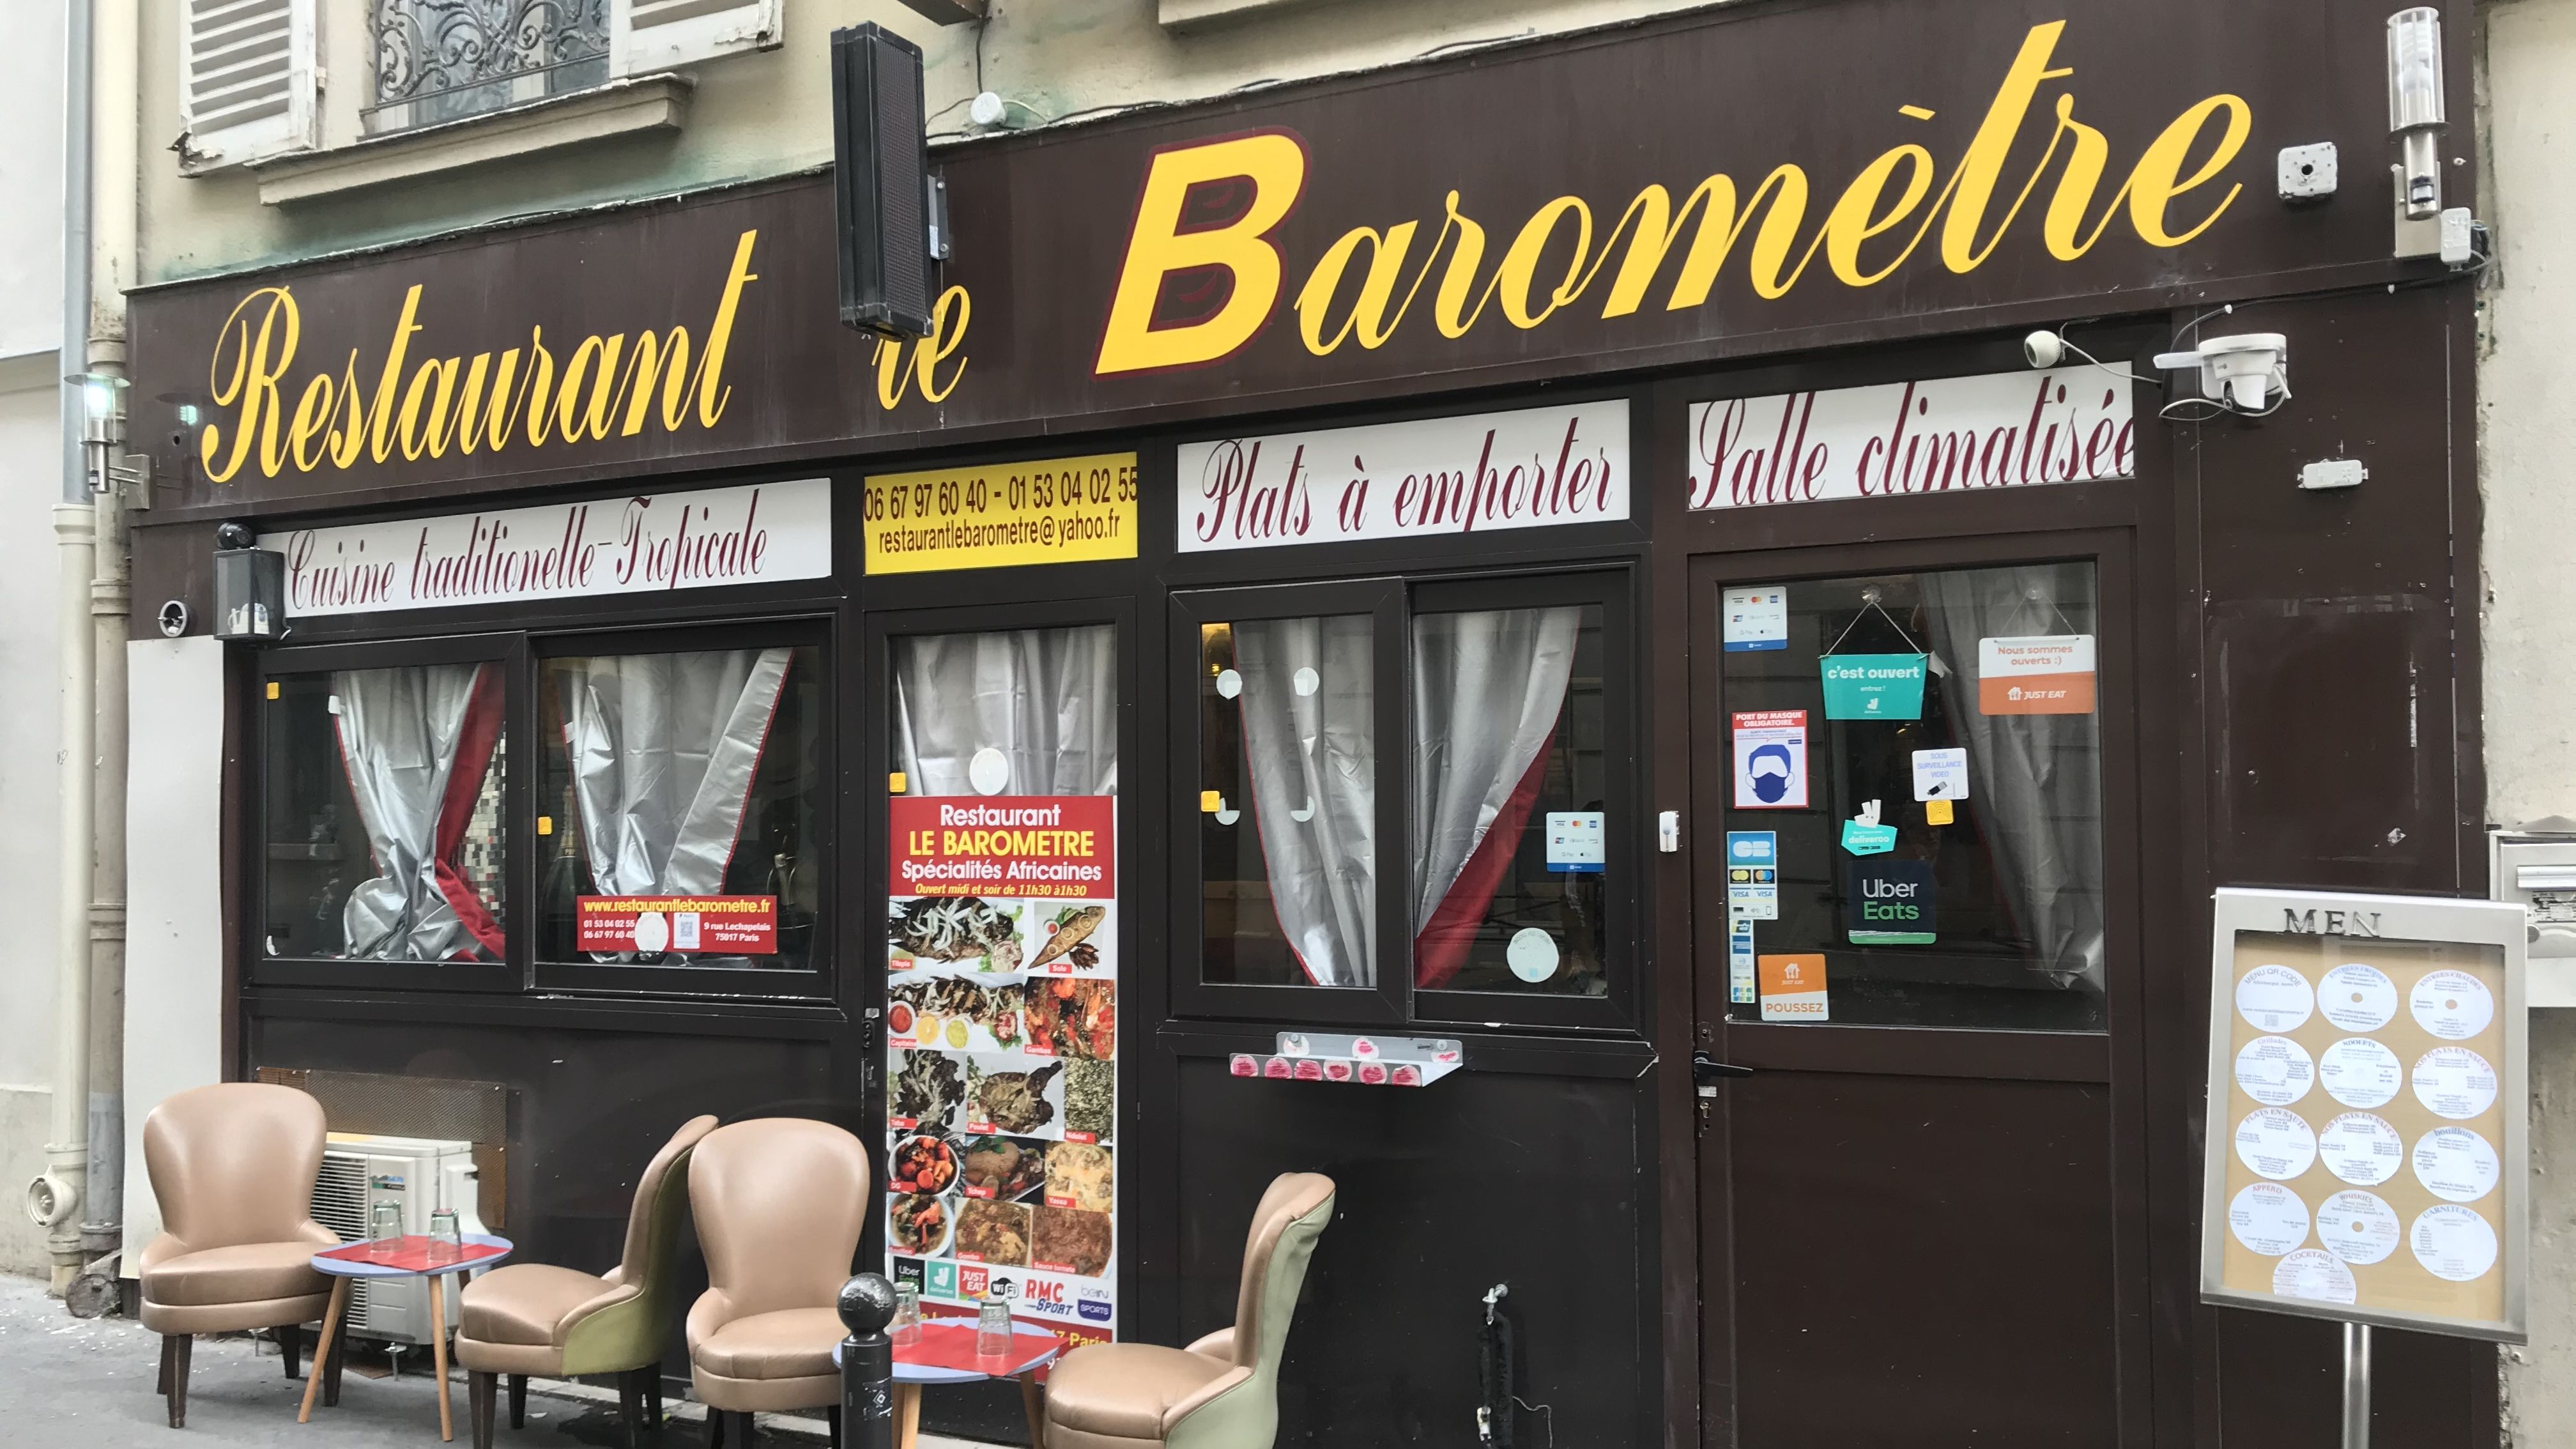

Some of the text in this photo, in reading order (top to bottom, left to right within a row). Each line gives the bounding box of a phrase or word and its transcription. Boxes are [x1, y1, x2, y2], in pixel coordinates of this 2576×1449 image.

[201, 229, 758, 483] Restaurant
[1092, 19, 2252, 378] Baromètre
[1689, 376, 2135, 510] Salle climatisée
[1196, 417, 1613, 542] Plats à emporter
[864, 486, 884, 522] 06
[890, 485, 908, 519] 67
[914, 484, 933, 518] 97
[939, 480, 959, 516] 60
[966, 479, 987, 513] 40
[1009, 475, 1027, 510] 01
[1033, 473, 1054, 509] 53
[1061, 470, 1082, 507] 04
[1089, 468, 1111, 504] 02
[1119, 466, 1138, 503] 55
[287, 529, 396, 611] Cuisine
[1998, 645, 2073, 655] Nous sommes
[2011, 657, 2051, 666] ouverts
[1827, 665, 1920, 679] c'est ouvert
[2023, 690, 2066, 700] JUST EAT
[1917, 761, 1961, 769] SURVEILLANCE
[940, 803, 1062, 827] Restaurant
[910, 830, 1094, 857] LE BAROMETRE
[1848, 835, 1890, 844] deliveroo
[901, 858, 1102, 882] Spécialités Africaines
[915, 883, 1087, 896] Ouvert midi et soir de 11h30 à1h30
[1862, 878, 1918, 898] Uber
[583, 898, 770, 913] www.restaurantlebarometre.fr
[1863, 901, 1920, 920] Eats
[703, 922, 710, 930] 9
[2283, 908, 2382, 938] MEN
[594, 930, 604, 939] 67
[604, 930, 614, 939] 97
[715, 933, 760, 942] 75017 Paris
[2244, 969, 2266, 985] MENU
[2281, 970, 2303, 986] CODE
[1765, 1003, 1824, 1013] POUSSEZ
[2244, 1110, 2268, 1124] PLATS
[2253, 1184, 2283, 1194] APPERO
[2339, 1193, 2373, 1203] WHISKIES
[2290, 1252, 2334, 1264] COCKTAILS
[898, 1265, 921, 1276] Uber
[962, 1270, 986, 1282] JUST
[967, 1282, 986, 1292] EAT
[1025, 1278, 1064, 1303] RMC
[1080, 1304, 1109, 1315] SPORTS
